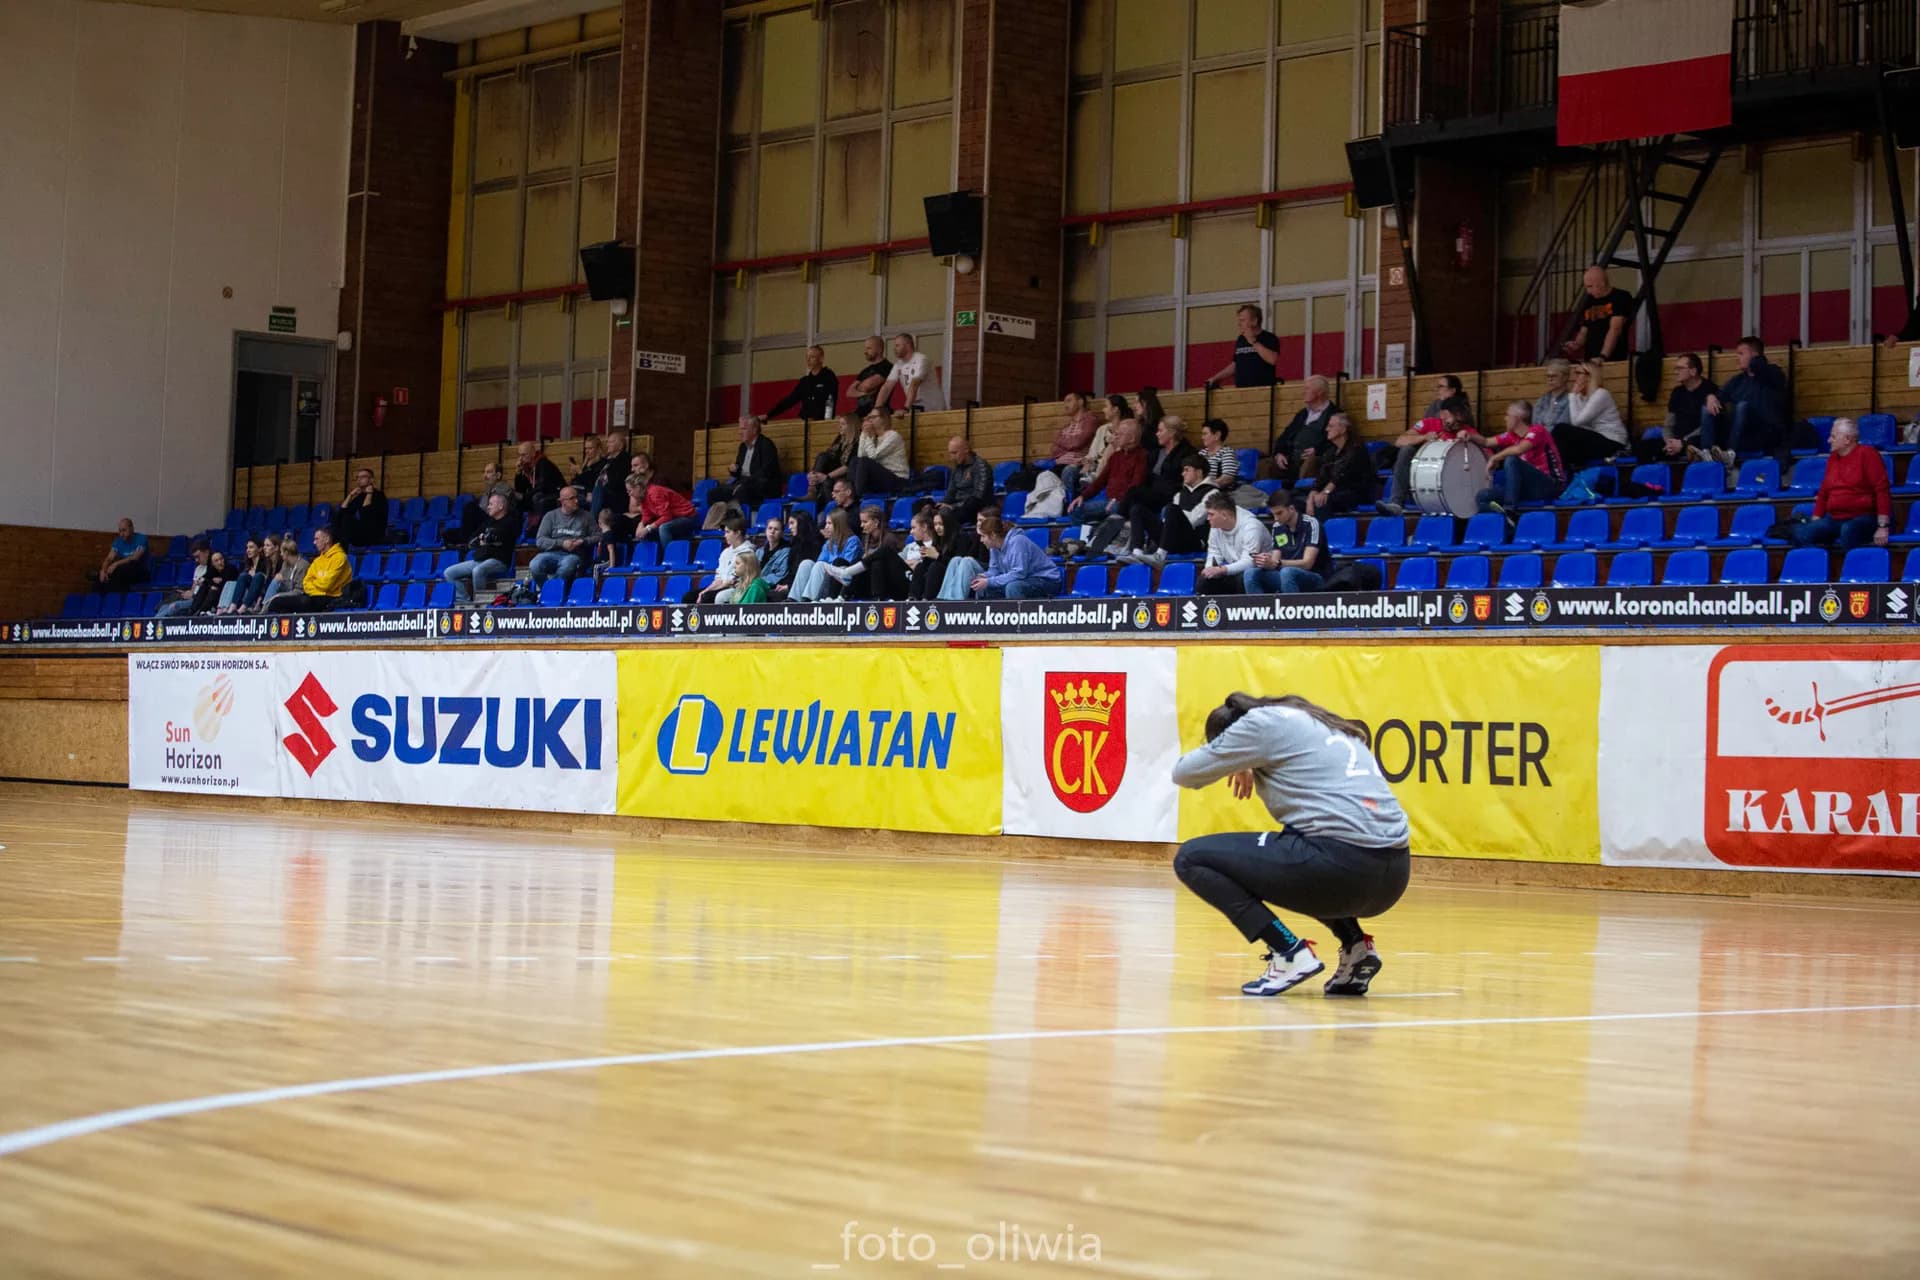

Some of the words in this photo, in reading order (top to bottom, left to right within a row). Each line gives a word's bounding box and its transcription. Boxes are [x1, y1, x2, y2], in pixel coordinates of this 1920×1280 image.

[987, 321, 1003, 333] A
[988, 314, 1032, 326] SEKTOR
[639, 358, 652, 369] B
[640, 352, 682, 362] SEKTOR
[944, 603, 1128, 630] www.koronahandball.pl
[1227, 595, 1442, 624] www.koronahandball.pl
[1557, 591, 1811, 622] www.koronahandball.pl
[166, 618, 267, 639] www.koronahandball.pl
[498, 610, 633, 632] www.koronahandball.pl
[704, 607, 861, 631] www.koronahandball.pl
[136, 659, 159, 672] WŁĄCZ
[160, 657, 179, 670] SWÓJ
[180, 660, 199, 672] PRĄD
[201, 660, 206, 670] Z
[207, 660, 221, 670] SUN
[222, 660, 253, 670] HORIZON
[255, 660, 269, 670] S.A.
[165, 720, 191, 743] Sun
[351, 693, 602, 770] SUZUKI
[727, 699, 957, 770] LEWIATAN
[166, 747, 222, 770] Horizon
[1052, 727, 1110, 795] CK
[161, 775, 239, 788] www.sunhorizon.pl
